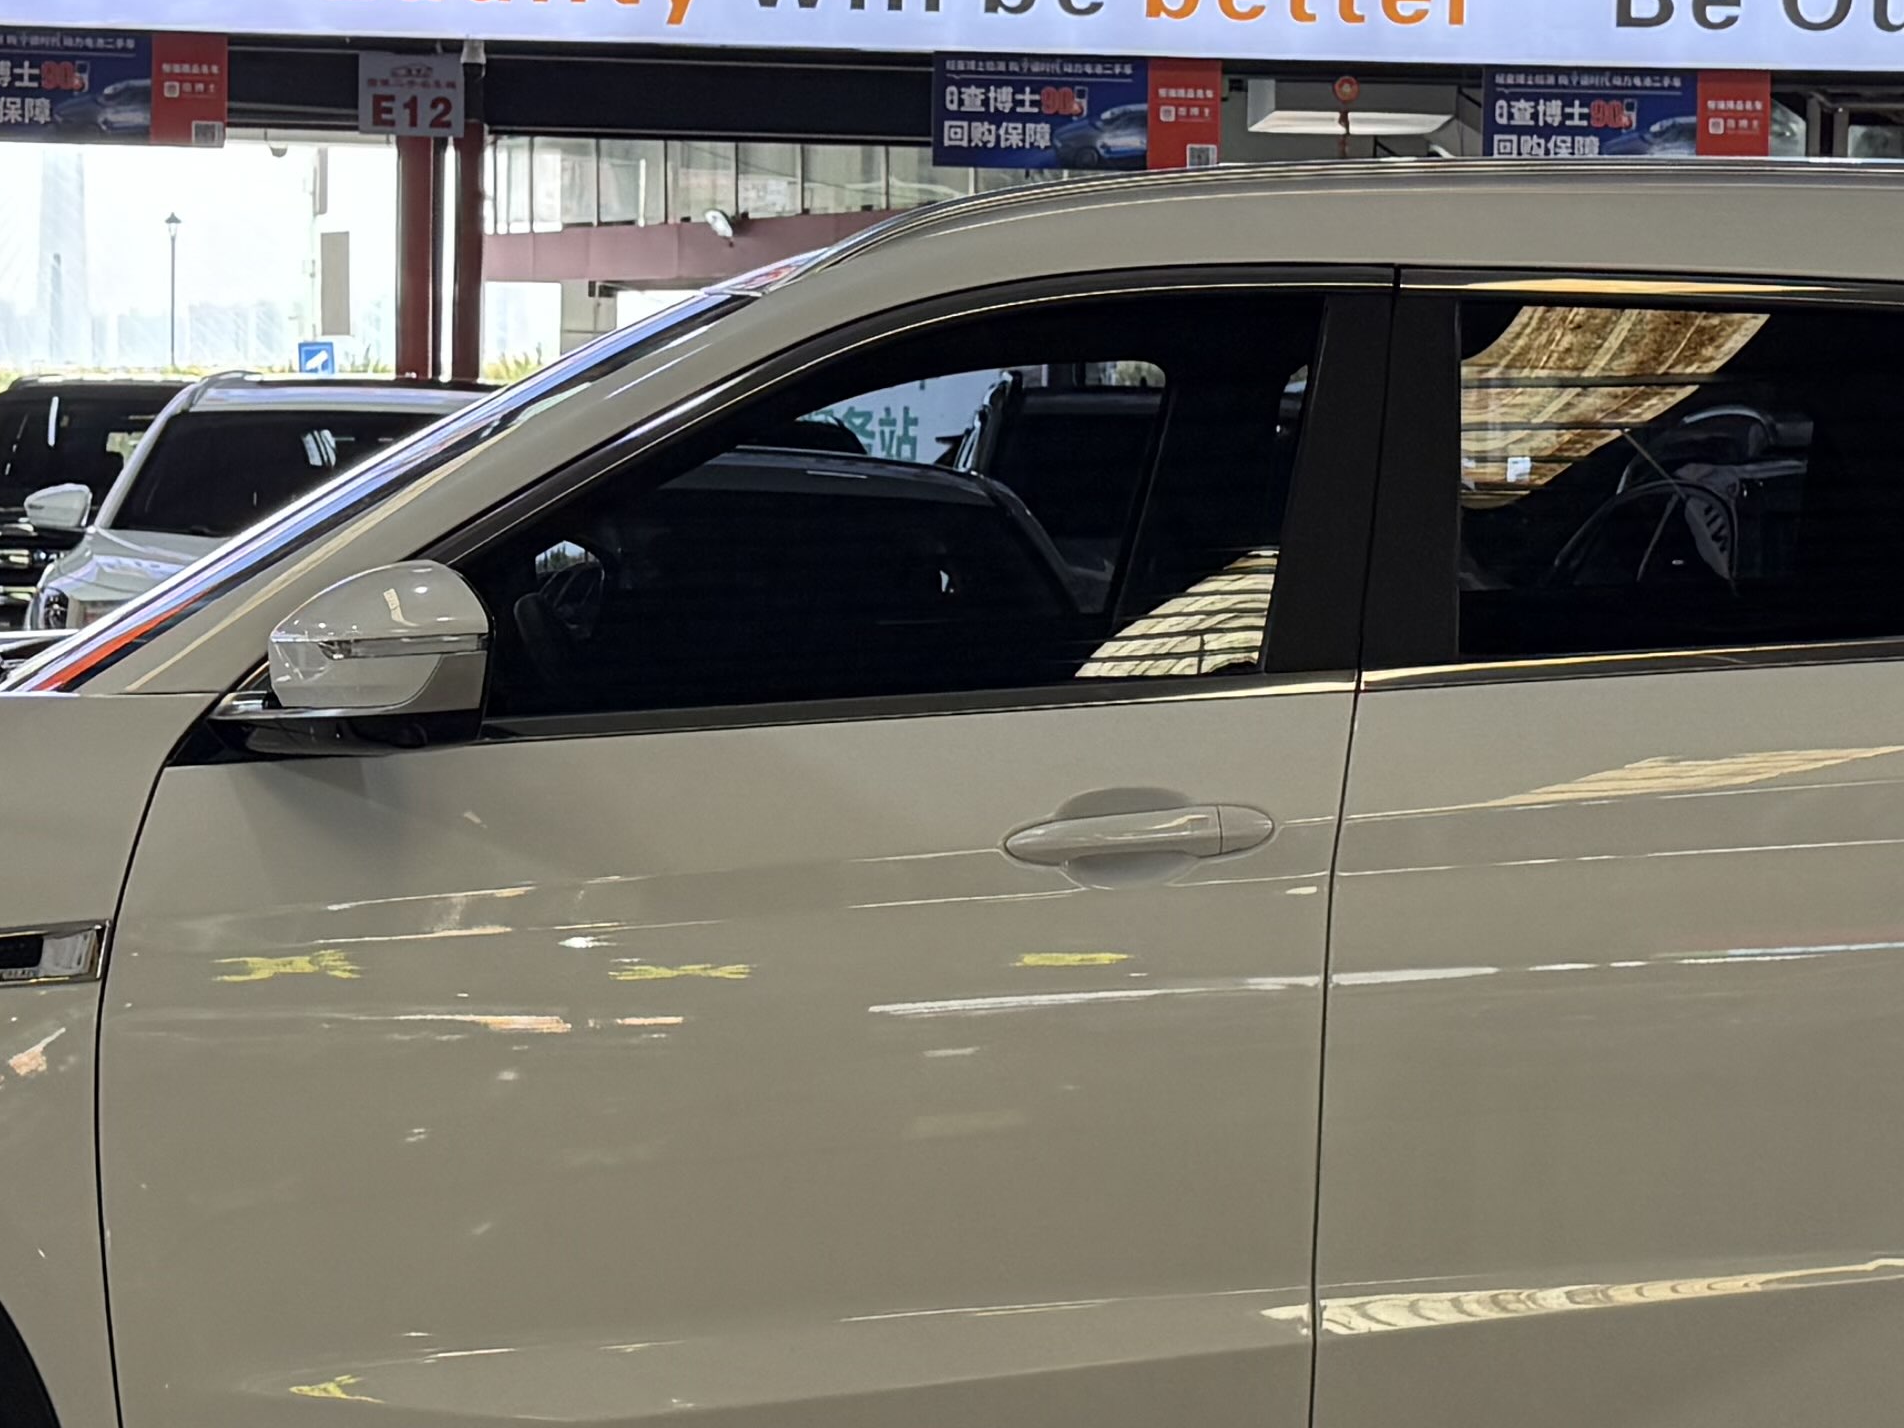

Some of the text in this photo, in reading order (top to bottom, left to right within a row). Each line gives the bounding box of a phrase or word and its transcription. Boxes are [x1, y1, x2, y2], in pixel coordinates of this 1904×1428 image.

[372, 94, 452, 129] E12
[944, 121, 1052, 149] 回购保障
